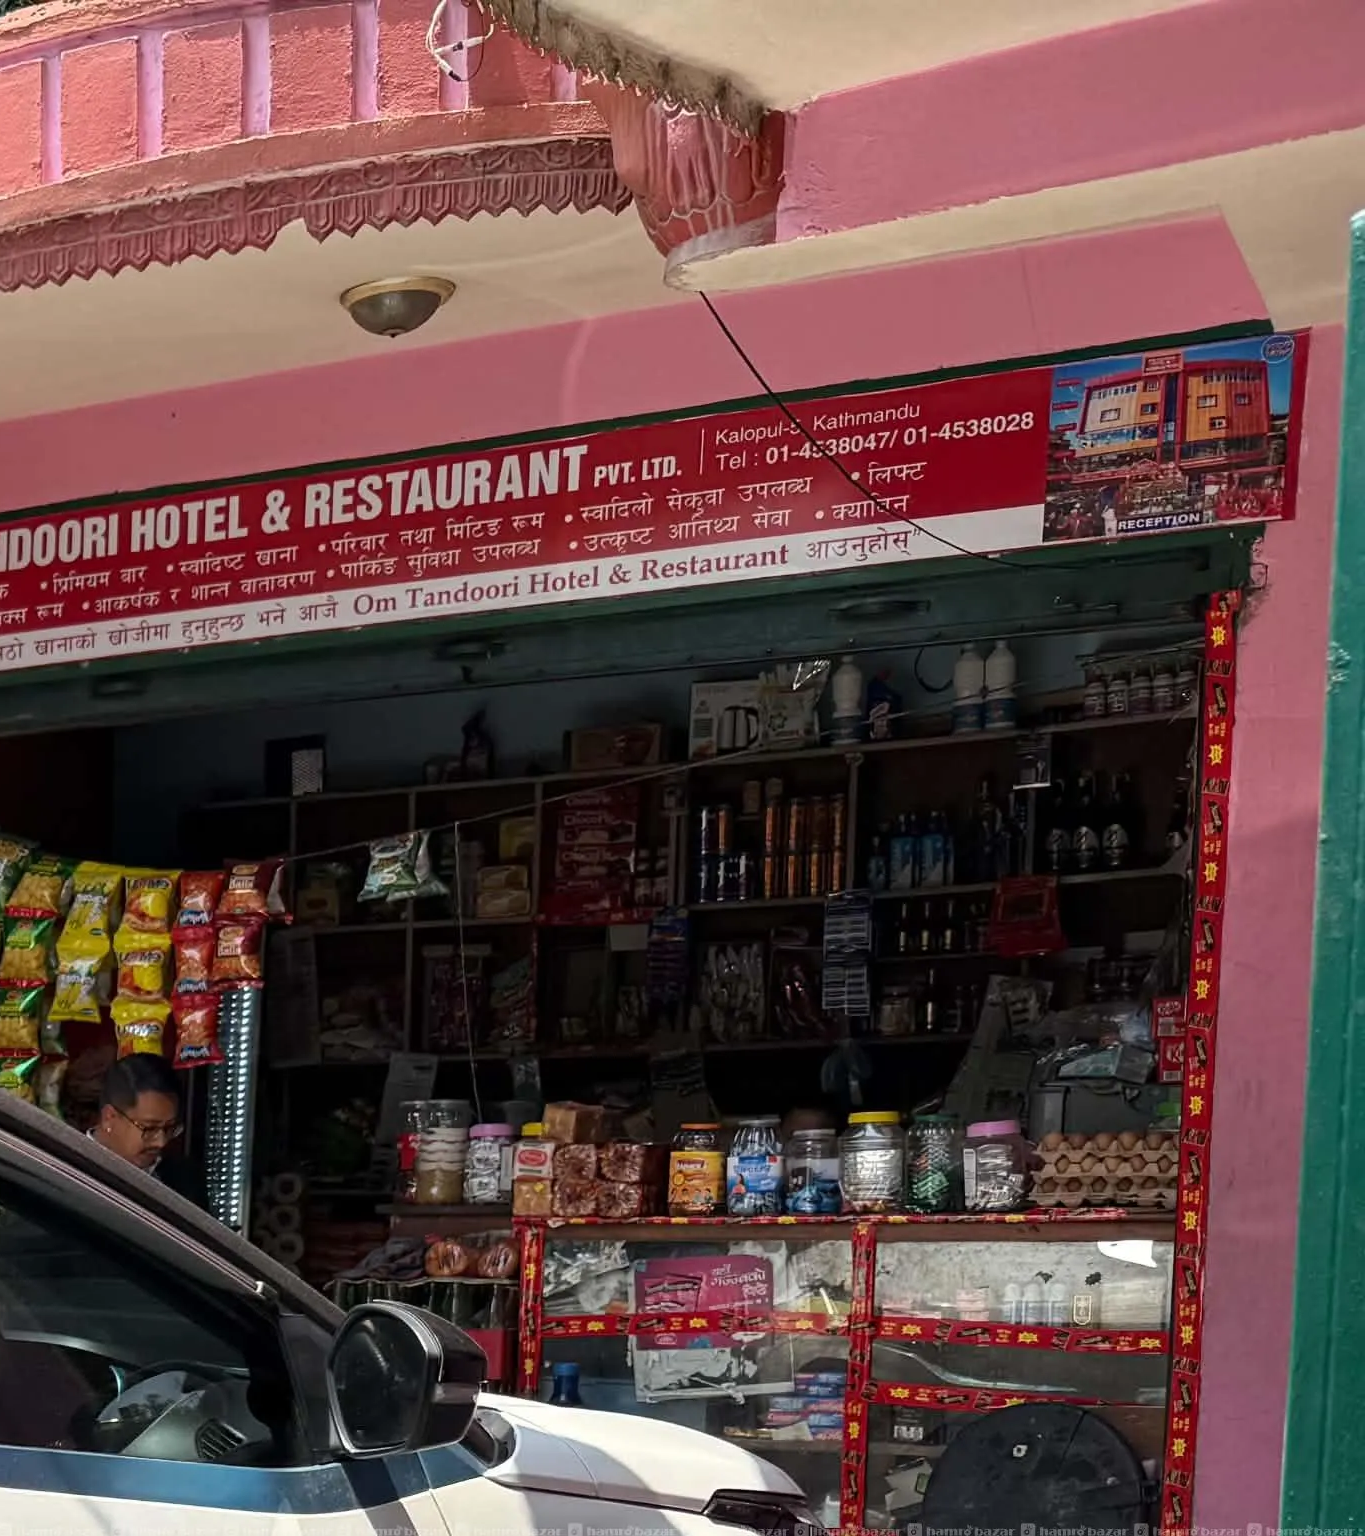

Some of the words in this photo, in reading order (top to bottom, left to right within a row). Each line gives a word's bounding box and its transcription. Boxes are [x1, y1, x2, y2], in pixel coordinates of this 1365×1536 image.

[812, 403, 921, 432] Kathmandu
[903, 412, 1035, 445] 01-4538028
[130, 496, 248, 553] HOTEL
[261, 489, 291, 535] &
[304, 444, 589, 529] RESTAURANT
[593, 463, 636, 488] PVT.
[641, 455, 682, 481] LTD.
[753, 505, 792, 529] सेवा
[1118, 512, 1200, 531] RECEPTION
[399, 526, 435, 547] तथा
[257, 602, 287, 627] भने
[353, 593, 396, 616] Om
[406, 575, 519, 609] Tandoori
[527, 565, 599, 594] Hotel
[608, 563, 631, 585] &
[638, 544, 789, 582] Restaurant
